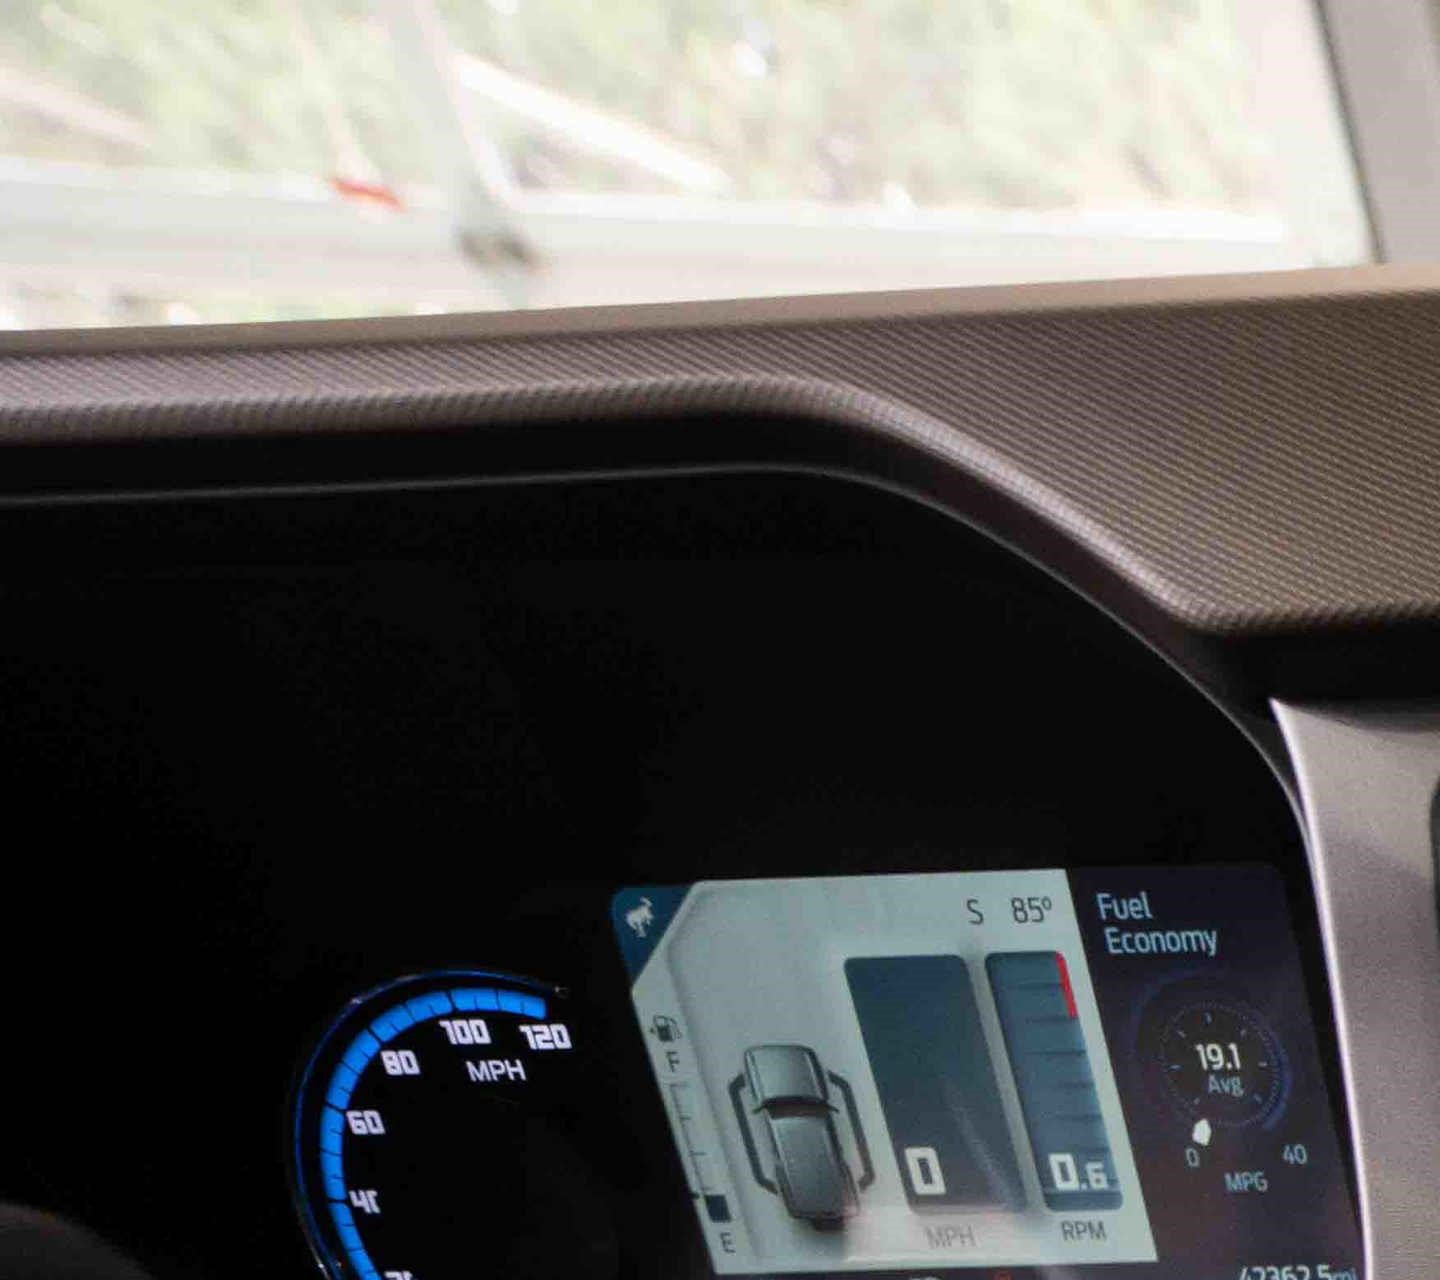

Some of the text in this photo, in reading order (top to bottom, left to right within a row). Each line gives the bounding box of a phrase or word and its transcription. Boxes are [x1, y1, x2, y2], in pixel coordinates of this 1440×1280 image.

[966, 899, 985, 925] S
[1096, 891, 1153, 922] Fuel
[1104, 928, 1218, 956] Economy
[439, 1018, 492, 1046] 100
[519, 1022, 573, 1051] 120
[380, 1049, 421, 1077] 80
[665, 1050, 681, 1072] F
[1195, 1042, 1243, 1071] 19.1
[466, 1059, 527, 1084] MPH
[1207, 1074, 1245, 1097] Avg
[345, 1109, 386, 1136] 60
[1186, 1148, 1200, 1168] 0
[1282, 1144, 1309, 1165] 40
[904, 1145, 948, 1196] 0
[1047, 1152, 1109, 1192] 0.6
[1224, 1171, 1269, 1193] MPG
[719, 1231, 737, 1254] E
[926, 1227, 975, 1248] MPH
[1060, 1219, 1108, 1242] RPM
